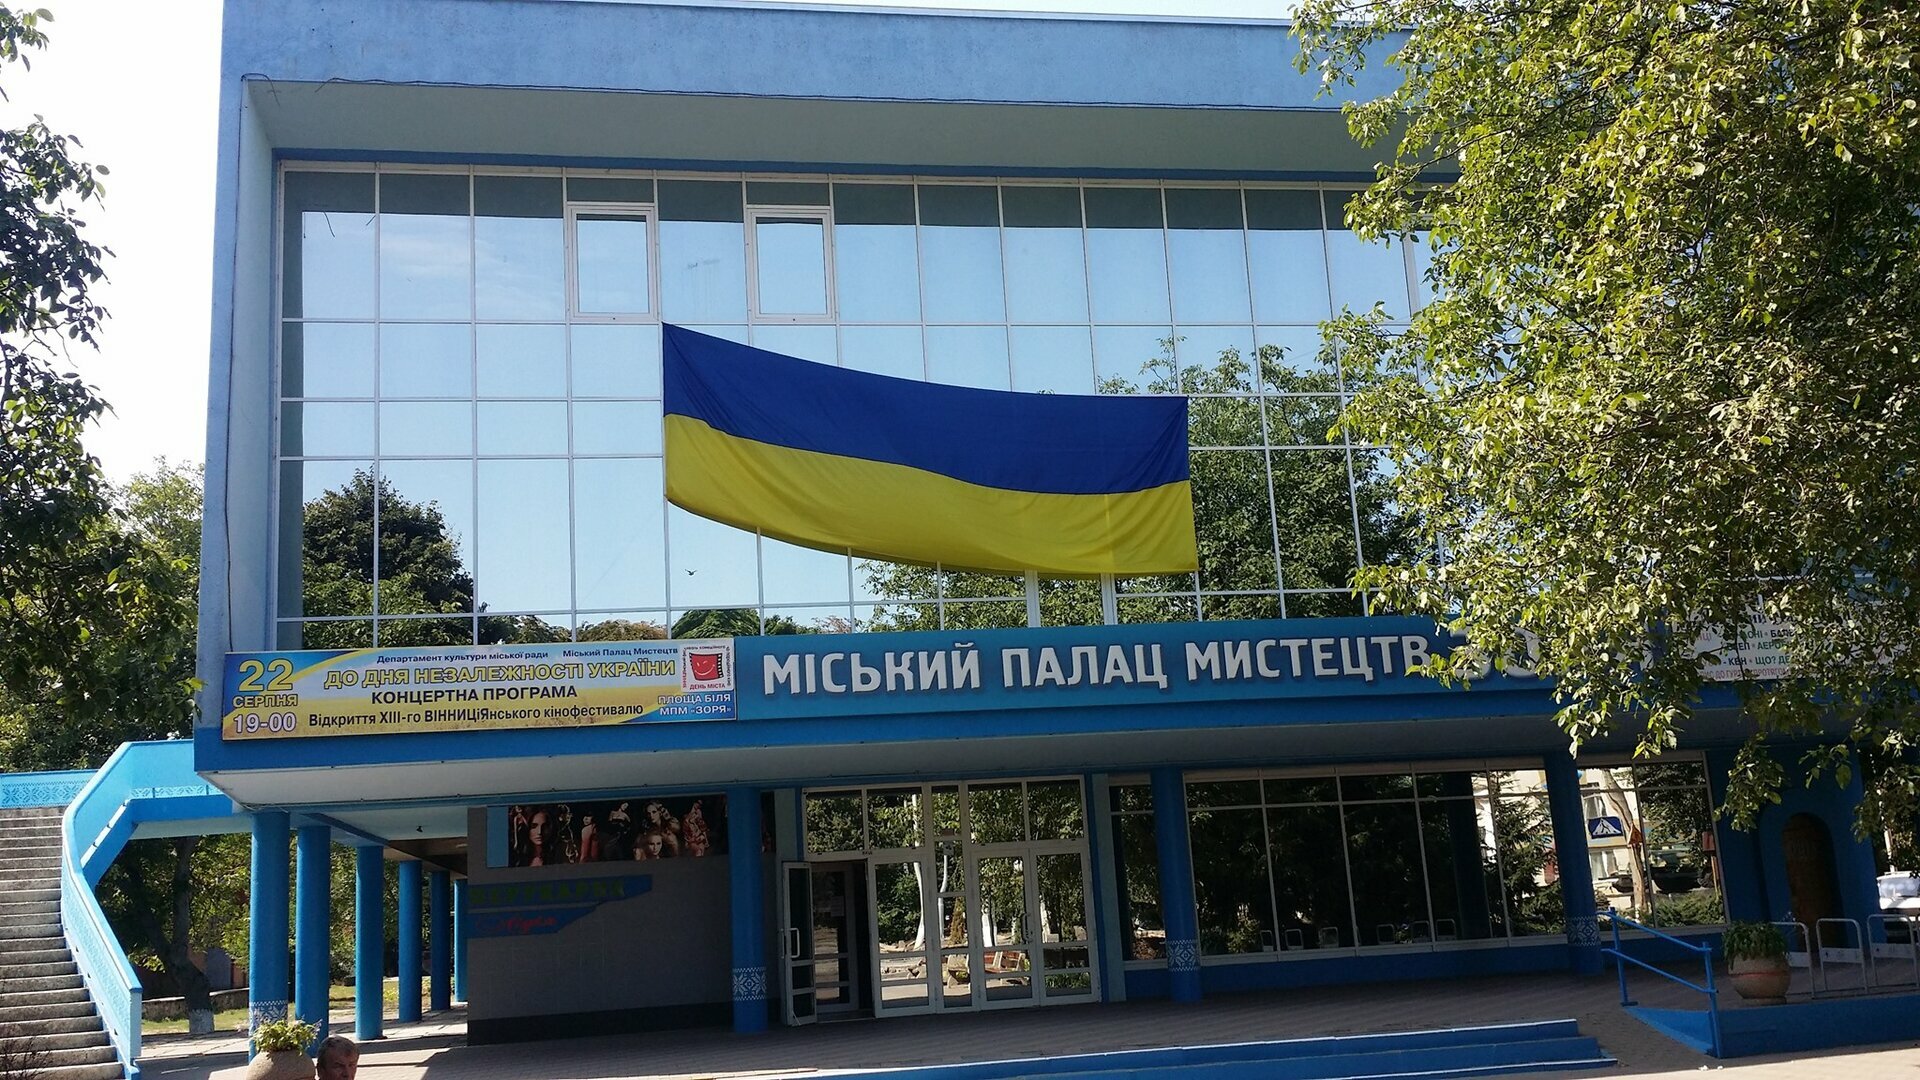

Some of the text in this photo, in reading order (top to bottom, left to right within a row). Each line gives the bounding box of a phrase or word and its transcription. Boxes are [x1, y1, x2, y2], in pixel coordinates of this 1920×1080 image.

[376, 651, 549, 664] Департамент культури міської ради
[602, 649, 633, 657] Палац
[633, 648, 678, 656] Мистецтв
[239, 657, 294, 692] 22
[324, 669, 359, 690] ДО
[361, 668, 410, 689] ДНЯ
[414, 662, 584, 685] НЕЗАЛЕЖНОСТІ
[588, 657, 676, 679] УКРАЇНИ
[763, 642, 981, 695] МІСЬКИЙ
[1002, 643, 1168, 689] ПАЛАЦ
[1185, 635, 1433, 682] МИСТЕЦТВ
[232, 694, 299, 708] СЕРПНЯ
[371, 685, 578, 705] КОНЦЕРТНА ПРОГРАМА
[658, 693, 731, 705] ПЛОЩА БІЛЯ
[309, 713, 376, 729] Відкриття
[424, 707, 541, 723] ВІННИЦіЯнського
[543, 704, 644, 719] кінофестивалю
[659, 704, 732, 716] МПМ «ЗОРЯ»
[233, 712, 297, 734] 19-00
